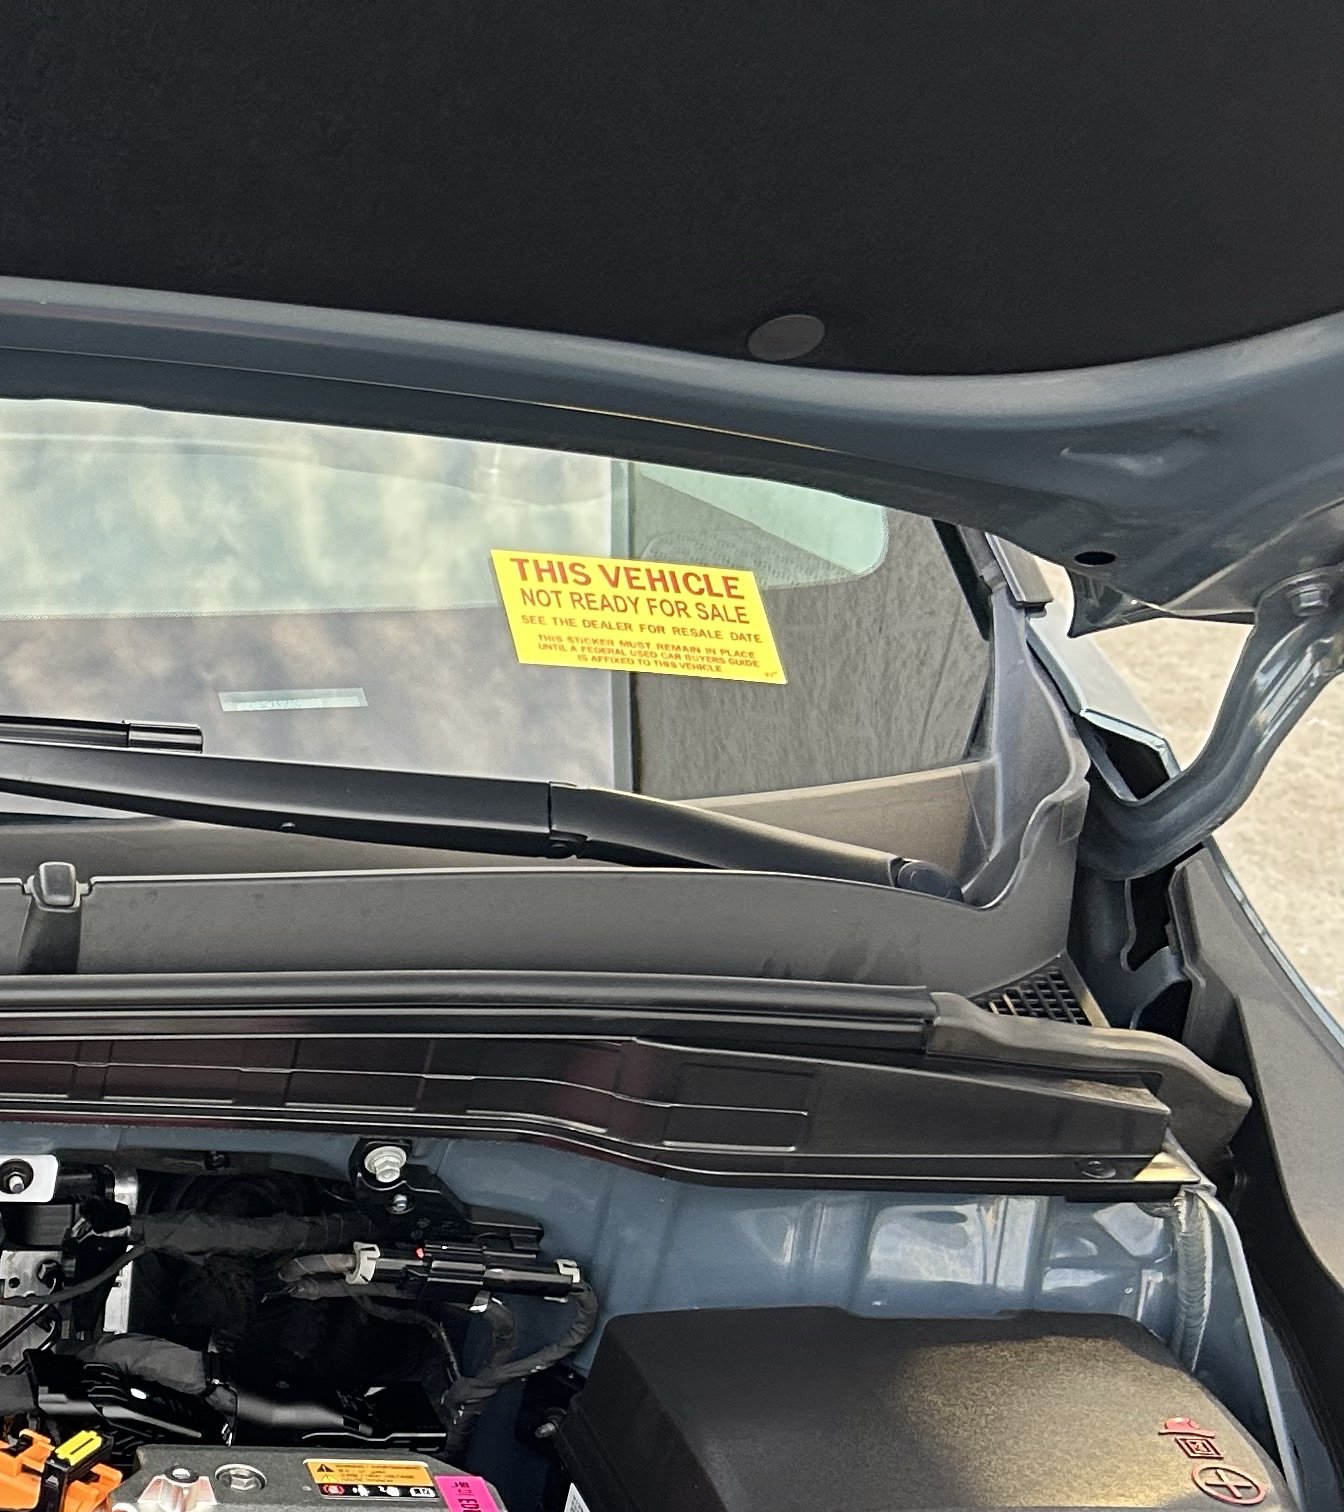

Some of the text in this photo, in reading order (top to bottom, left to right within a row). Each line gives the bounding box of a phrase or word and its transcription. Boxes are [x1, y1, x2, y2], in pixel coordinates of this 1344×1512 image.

[510, 558, 745, 599] THIS VEHICLE
[520, 588, 750, 624] NOT READY FOR SALE
[521, 615, 763, 643] SEE THE DEALER FOR RESALE DATE
[538, 634, 755, 658] THIS STICKER MUST REMAIN IN PLACE
[538, 643, 567, 652] UNTIL
[581, 646, 626, 656] FEDERAL
[630, 649, 657, 658] USED
[661, 652, 681, 660] CAR
[685, 654, 726, 664] BUYERS
[729, 658, 760, 668] GUIDE
[591, 656, 634, 665] AFFIXED
[638, 659, 651, 667] TO
[655, 660, 677, 668] THIS
[680, 661, 722, 672] VEHICLE
